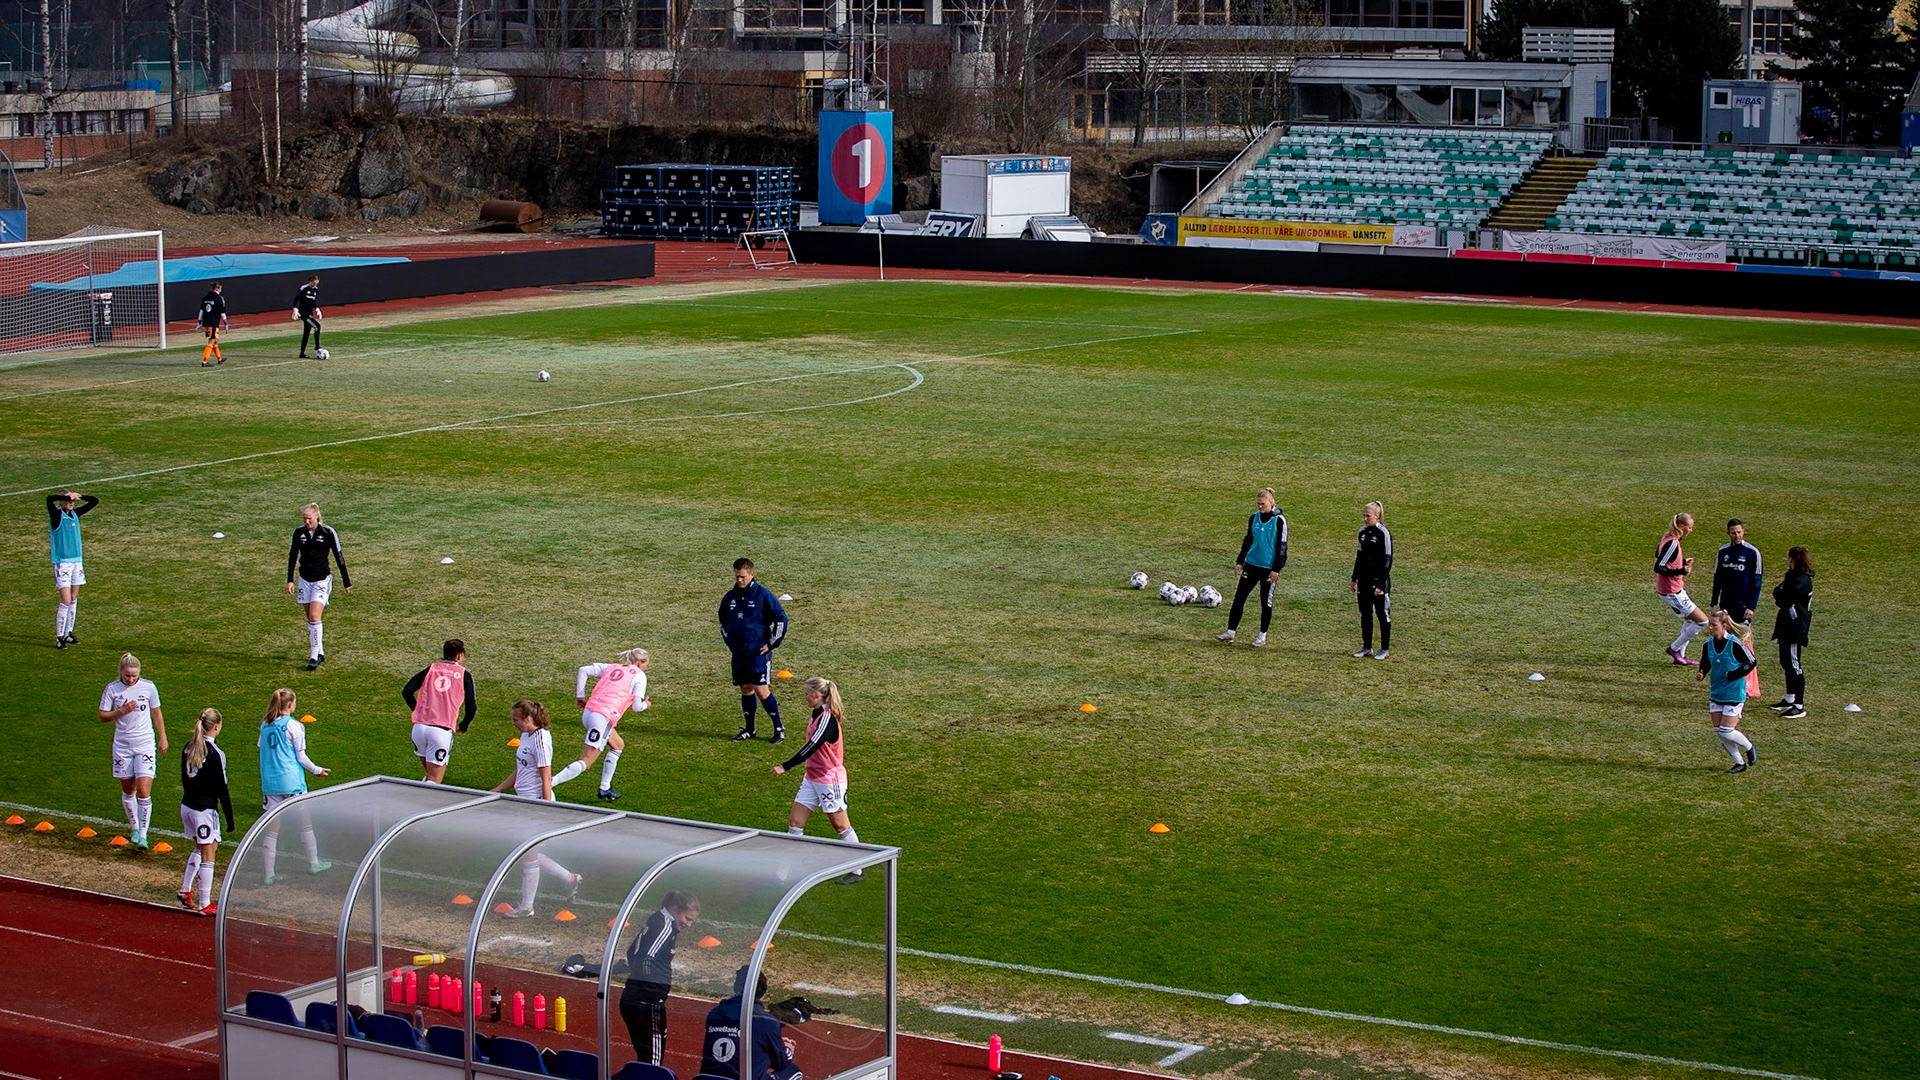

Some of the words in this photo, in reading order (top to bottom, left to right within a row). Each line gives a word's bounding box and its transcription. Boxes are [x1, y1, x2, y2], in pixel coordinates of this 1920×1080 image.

[1735, 97, 1762, 105] HIBAS
[851, 139, 872, 189] 1
[1183, 223, 1207, 232] ALLTID
[1208, 224, 1259, 235] LÆREPLASSER
[1261, 226, 1272, 235] TIL
[1274, 224, 1293, 236] VÅRE
[1295, 228, 1351, 239] UNGDOMMER.
[1352, 230, 1387, 240] UANSETT.
[1677, 249, 1720, 261] energima
